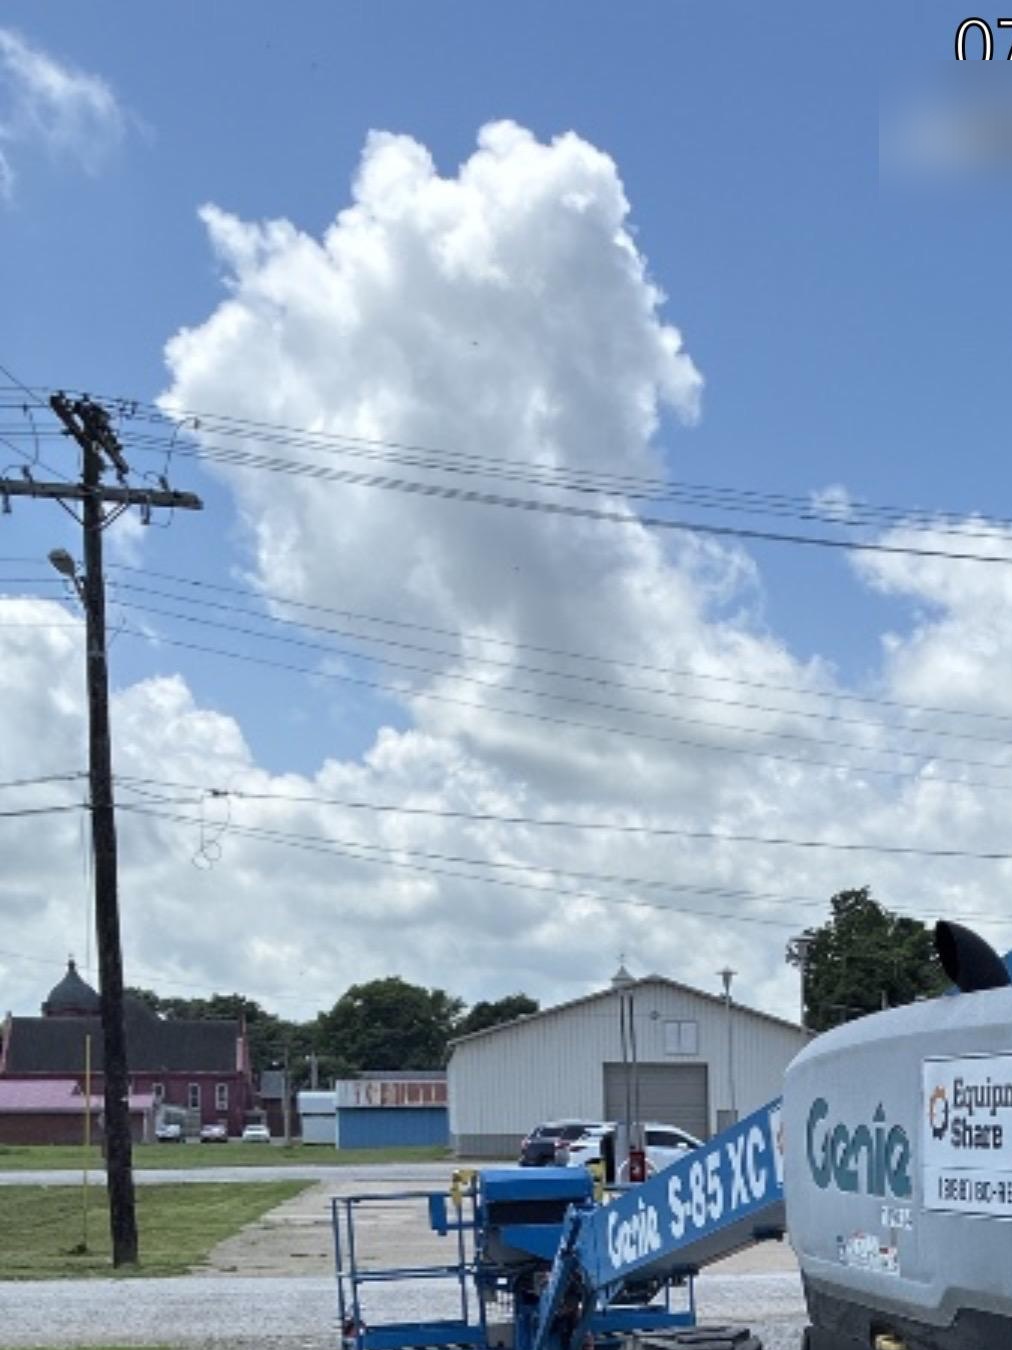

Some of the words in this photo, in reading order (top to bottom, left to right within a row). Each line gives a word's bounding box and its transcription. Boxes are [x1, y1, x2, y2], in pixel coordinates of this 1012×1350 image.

[807, 1098, 912, 1198] Genie
[951, 1117, 1003, 1149] Share
[608, 1196, 661, 1269] Genie
[668, 1151, 724, 1239] S-85
[725, 1126, 766, 1210] XC
